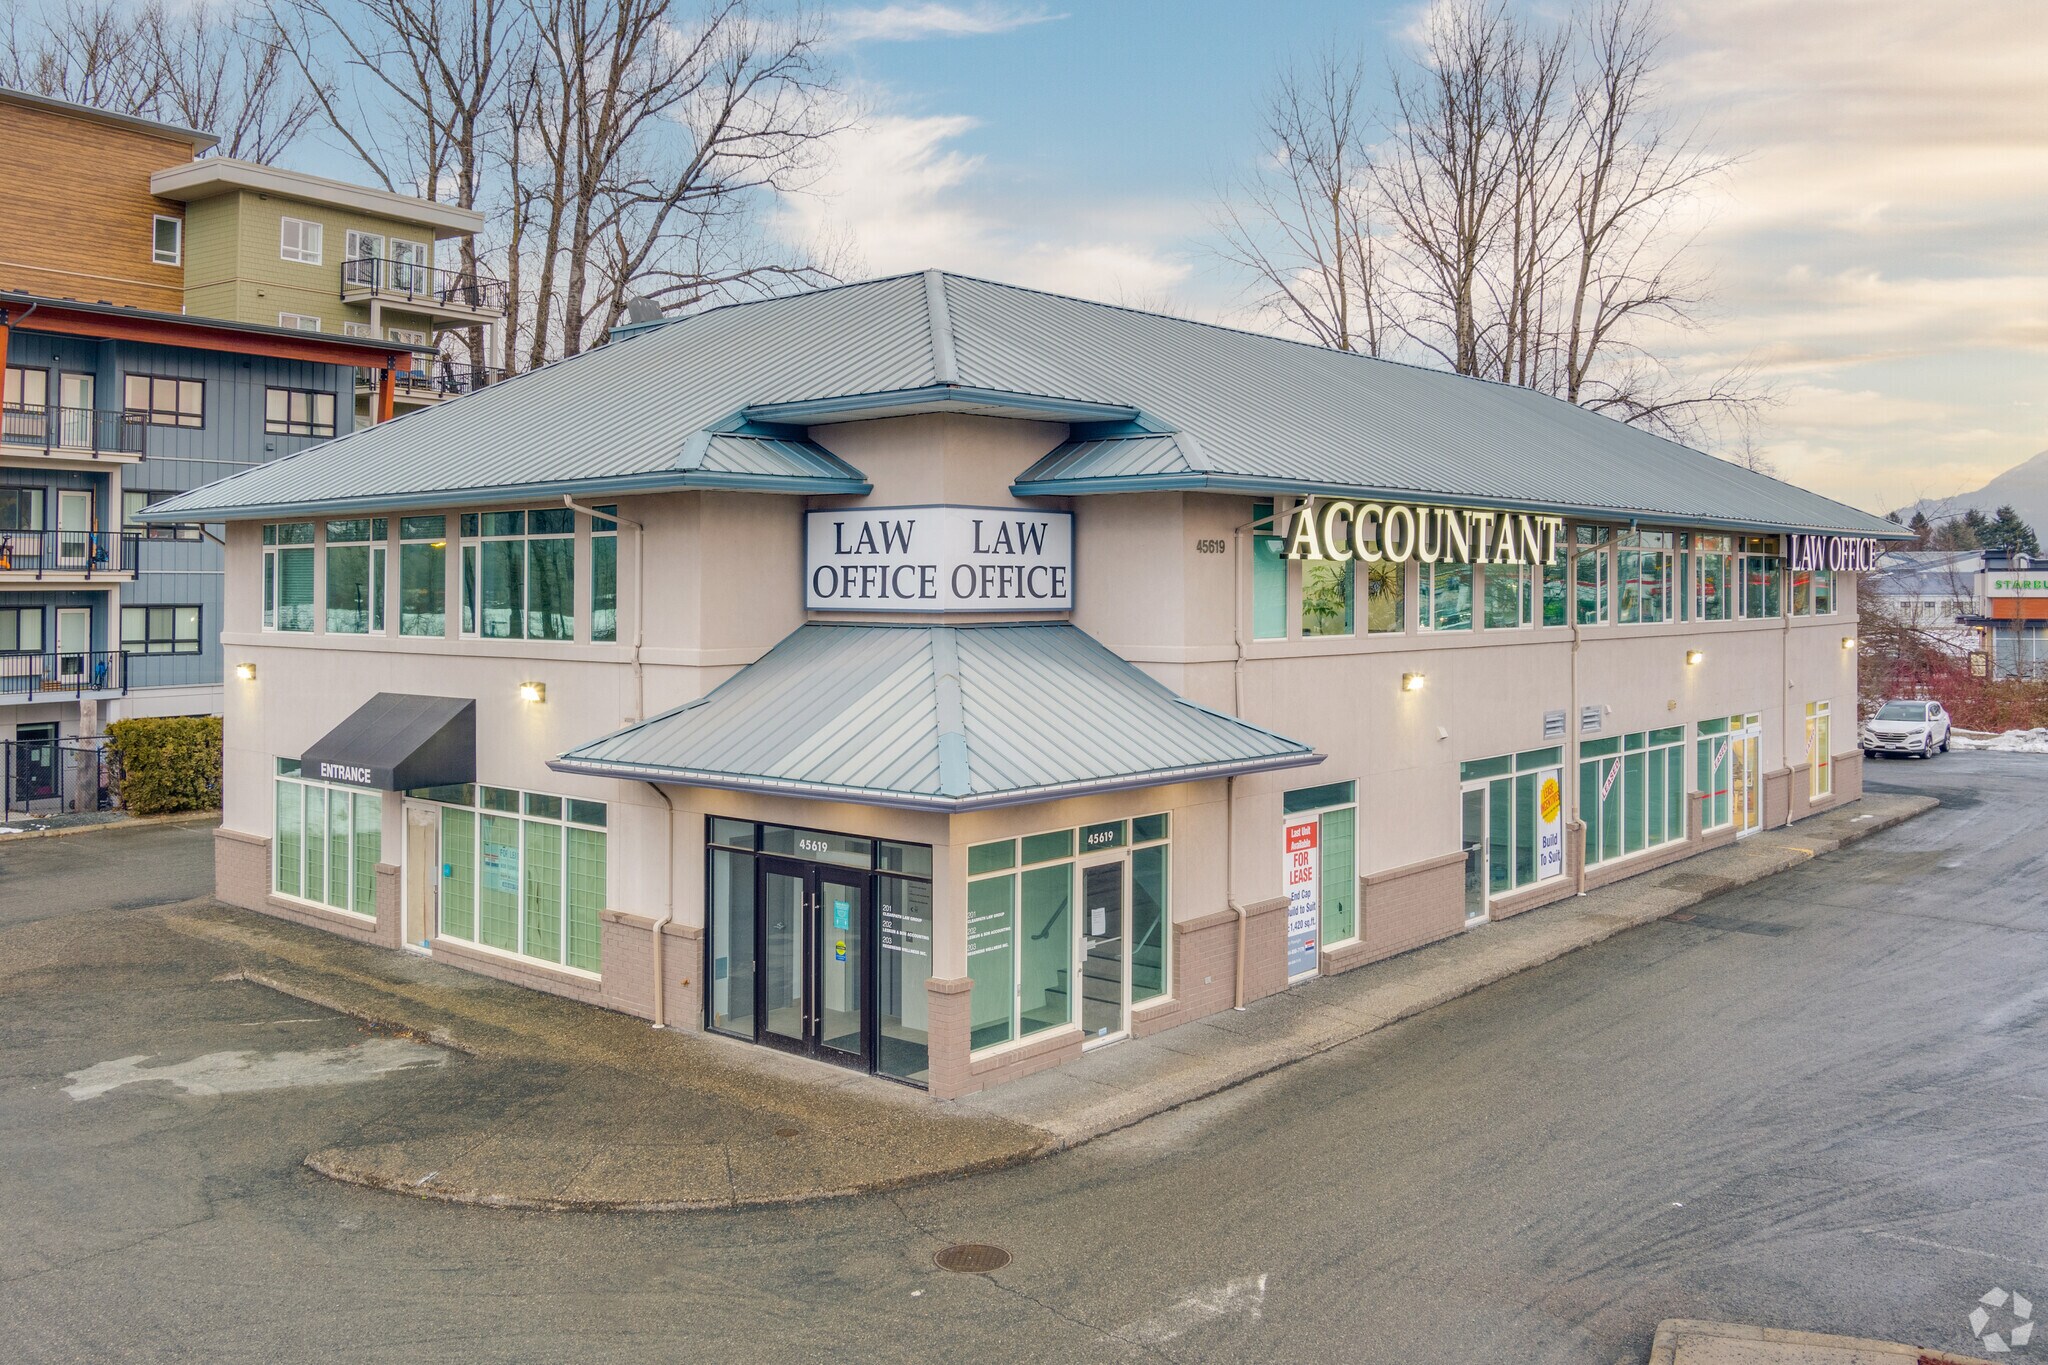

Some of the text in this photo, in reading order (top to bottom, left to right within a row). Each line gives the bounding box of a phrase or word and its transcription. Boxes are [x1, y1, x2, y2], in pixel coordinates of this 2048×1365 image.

[832, 519, 916, 555] LAW
[972, 519, 1048, 556] LAW
[1284, 500, 1563, 567] ACCOUNTANT
[1196, 539, 1226, 555] 45619
[1791, 534, 1877, 572] LAW OFFICE
[812, 564, 938, 600] OFFICE
[950, 563, 1067, 600] OFFICE
[320, 762, 371, 784] ENTRANCE
[1602, 759, 1619, 799] LEASED
[1088, 830, 1114, 845] 45619
[1291, 828, 1301, 838] Last
[1542, 833, 1558, 849] Build
[799, 839, 828, 853] 45619
[1293, 851, 1309, 868] FOR
[1540, 849, 1560, 866] To Suit
[1289, 867, 1312, 885] LEASE
[1291, 889, 1311, 901] End Cap
[882, 904, 892, 912] 201
[1299, 904, 1305, 915] to
[1306, 901, 1316, 913] Suit
[882, 919, 892, 928] 202
[882, 936, 893, 945] 203
